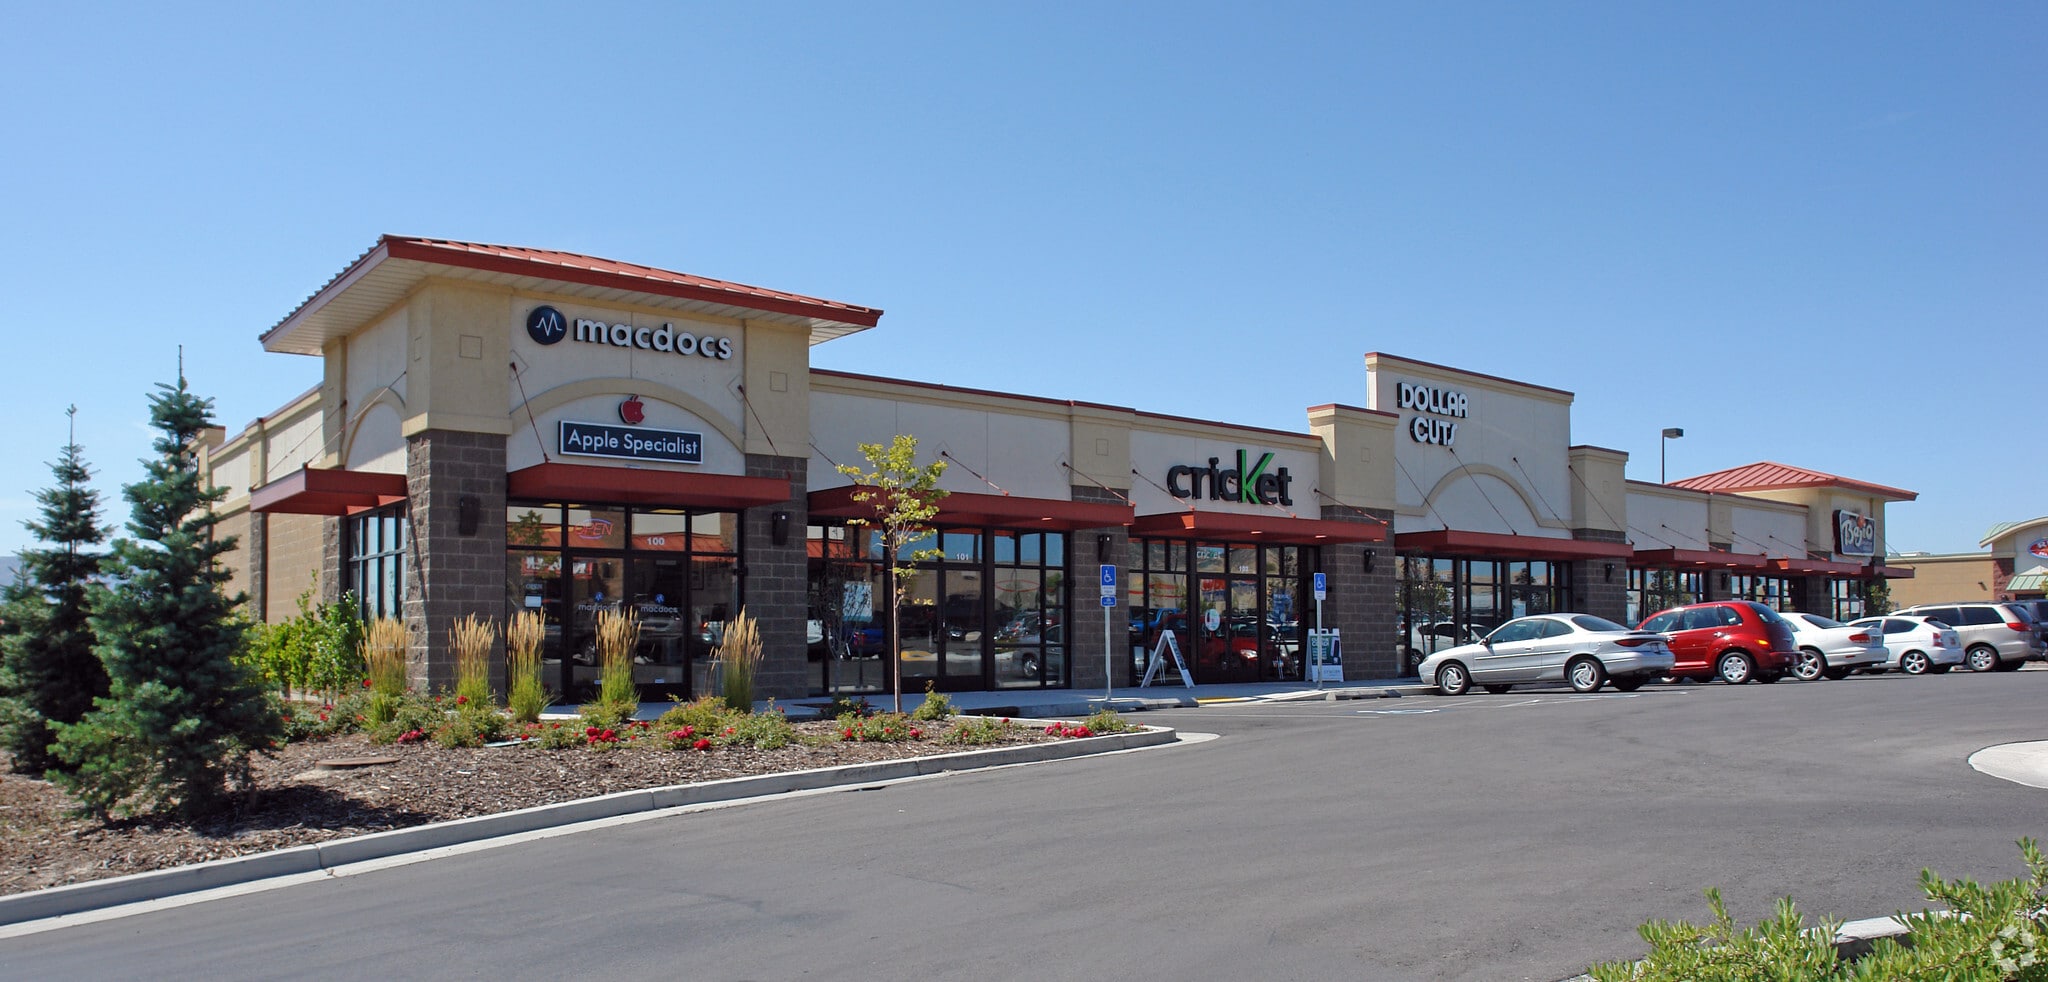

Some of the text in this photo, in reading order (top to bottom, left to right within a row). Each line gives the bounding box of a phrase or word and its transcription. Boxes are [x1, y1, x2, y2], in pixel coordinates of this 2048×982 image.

[575, 318, 732, 360] macdocs
[1397, 382, 1469, 418] DOLLAR
[568, 429, 697, 455] Apple Specialist
[1410, 416, 1457, 446] CUTS
[574, 522, 613, 536] OPEN
[647, 537, 665, 546] 100
[956, 553, 969, 561] 101
